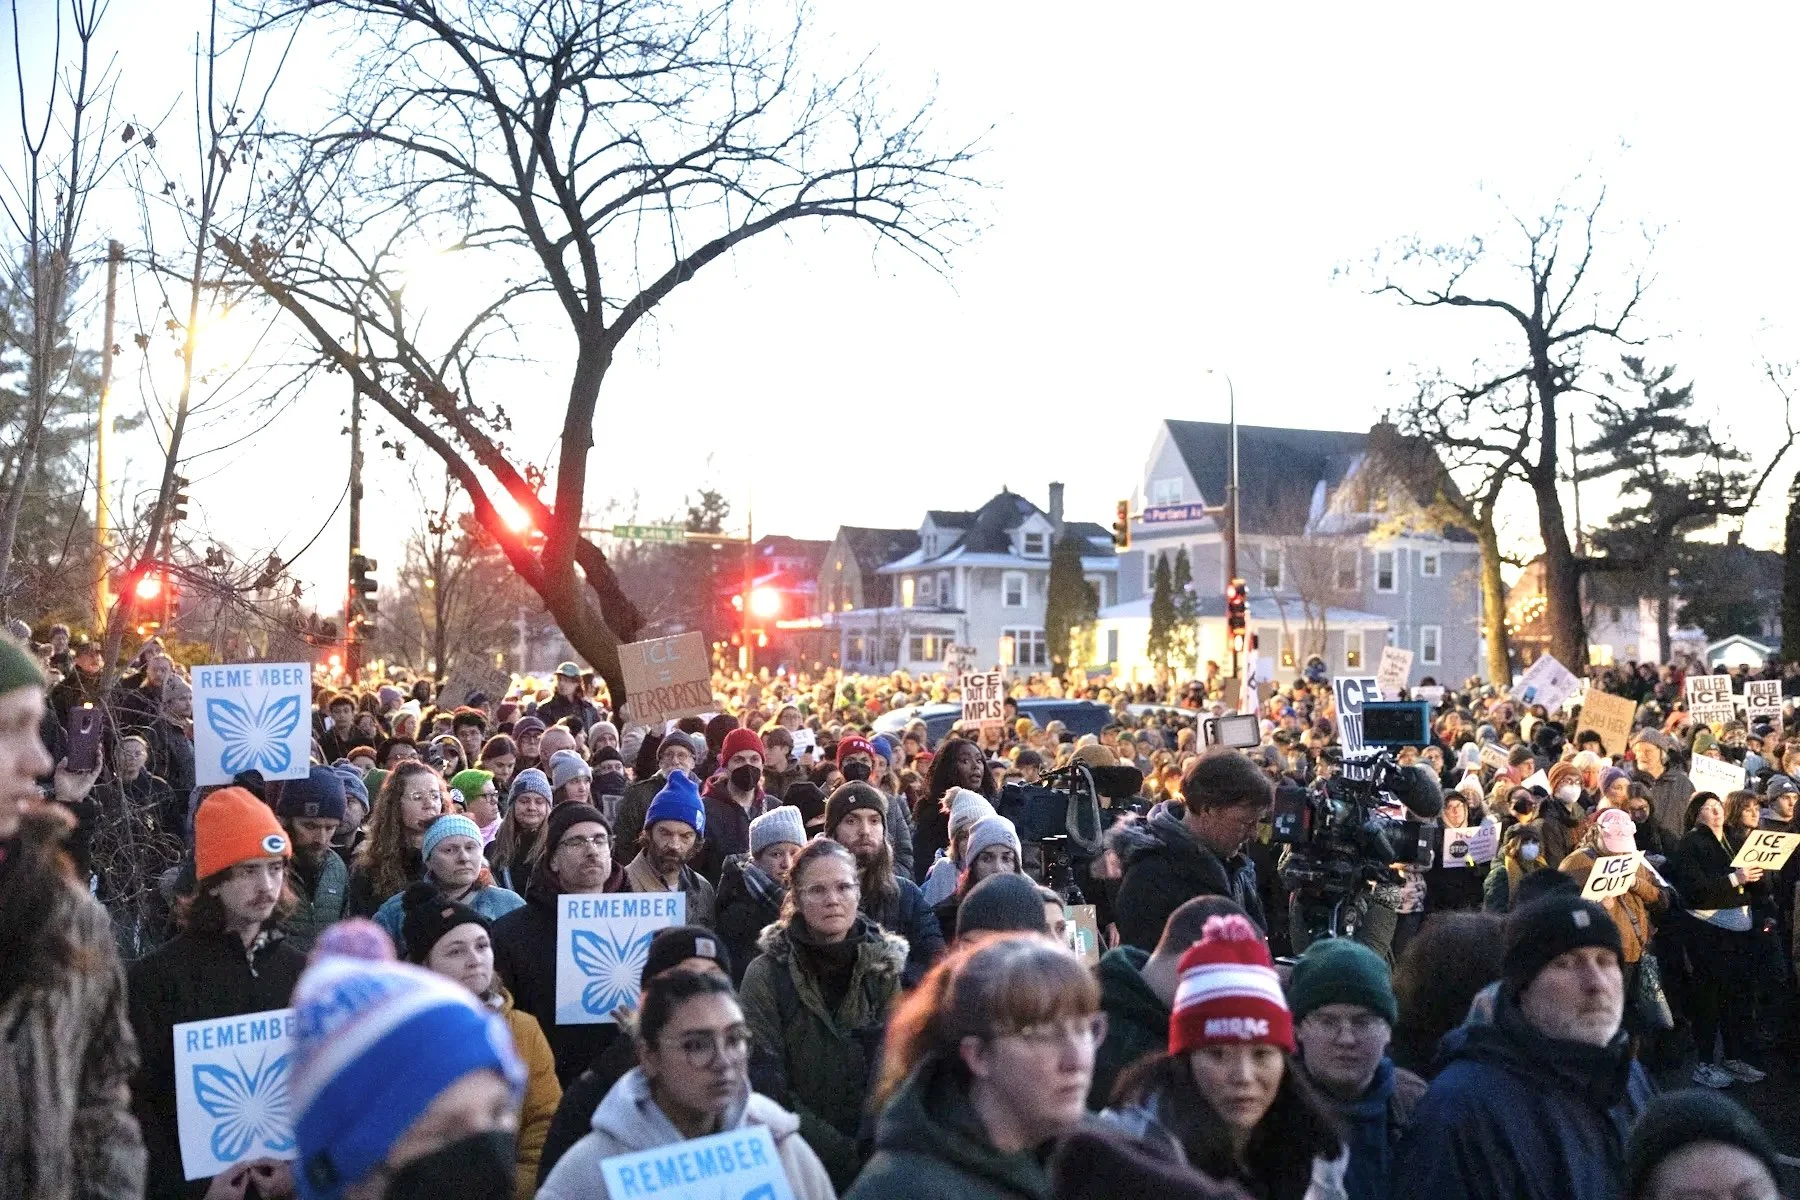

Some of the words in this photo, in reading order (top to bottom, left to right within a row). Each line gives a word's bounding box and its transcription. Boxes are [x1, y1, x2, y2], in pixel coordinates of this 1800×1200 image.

[641, 640, 680, 665] ICE
[201, 668, 303, 689] REMEMBER
[963, 674, 1000, 687] ICE
[1693, 678, 1726, 692] KILLER
[966, 687, 983, 701] OUT
[986, 686, 998, 699] OF
[1750, 682, 1777, 695] KILLER
[1335, 679, 1378, 714] ICE
[1691, 691, 1730, 704] ICE
[1747, 695, 1780, 707] ICE
[965, 701, 1001, 721] MPLS
[1692, 710, 1733, 724] STREETS
[1478, 827, 1494, 837] ICE
[1754, 834, 1786, 848] ICE
[1744, 849, 1781, 862] OUT
[1603, 857, 1632, 874] ICE
[1591, 873, 1633, 892] OUT
[568, 898, 676, 919] REMEMBER
[186, 1015, 300, 1052] REMEMBE
[618, 1138, 769, 1197] REMEMBER
